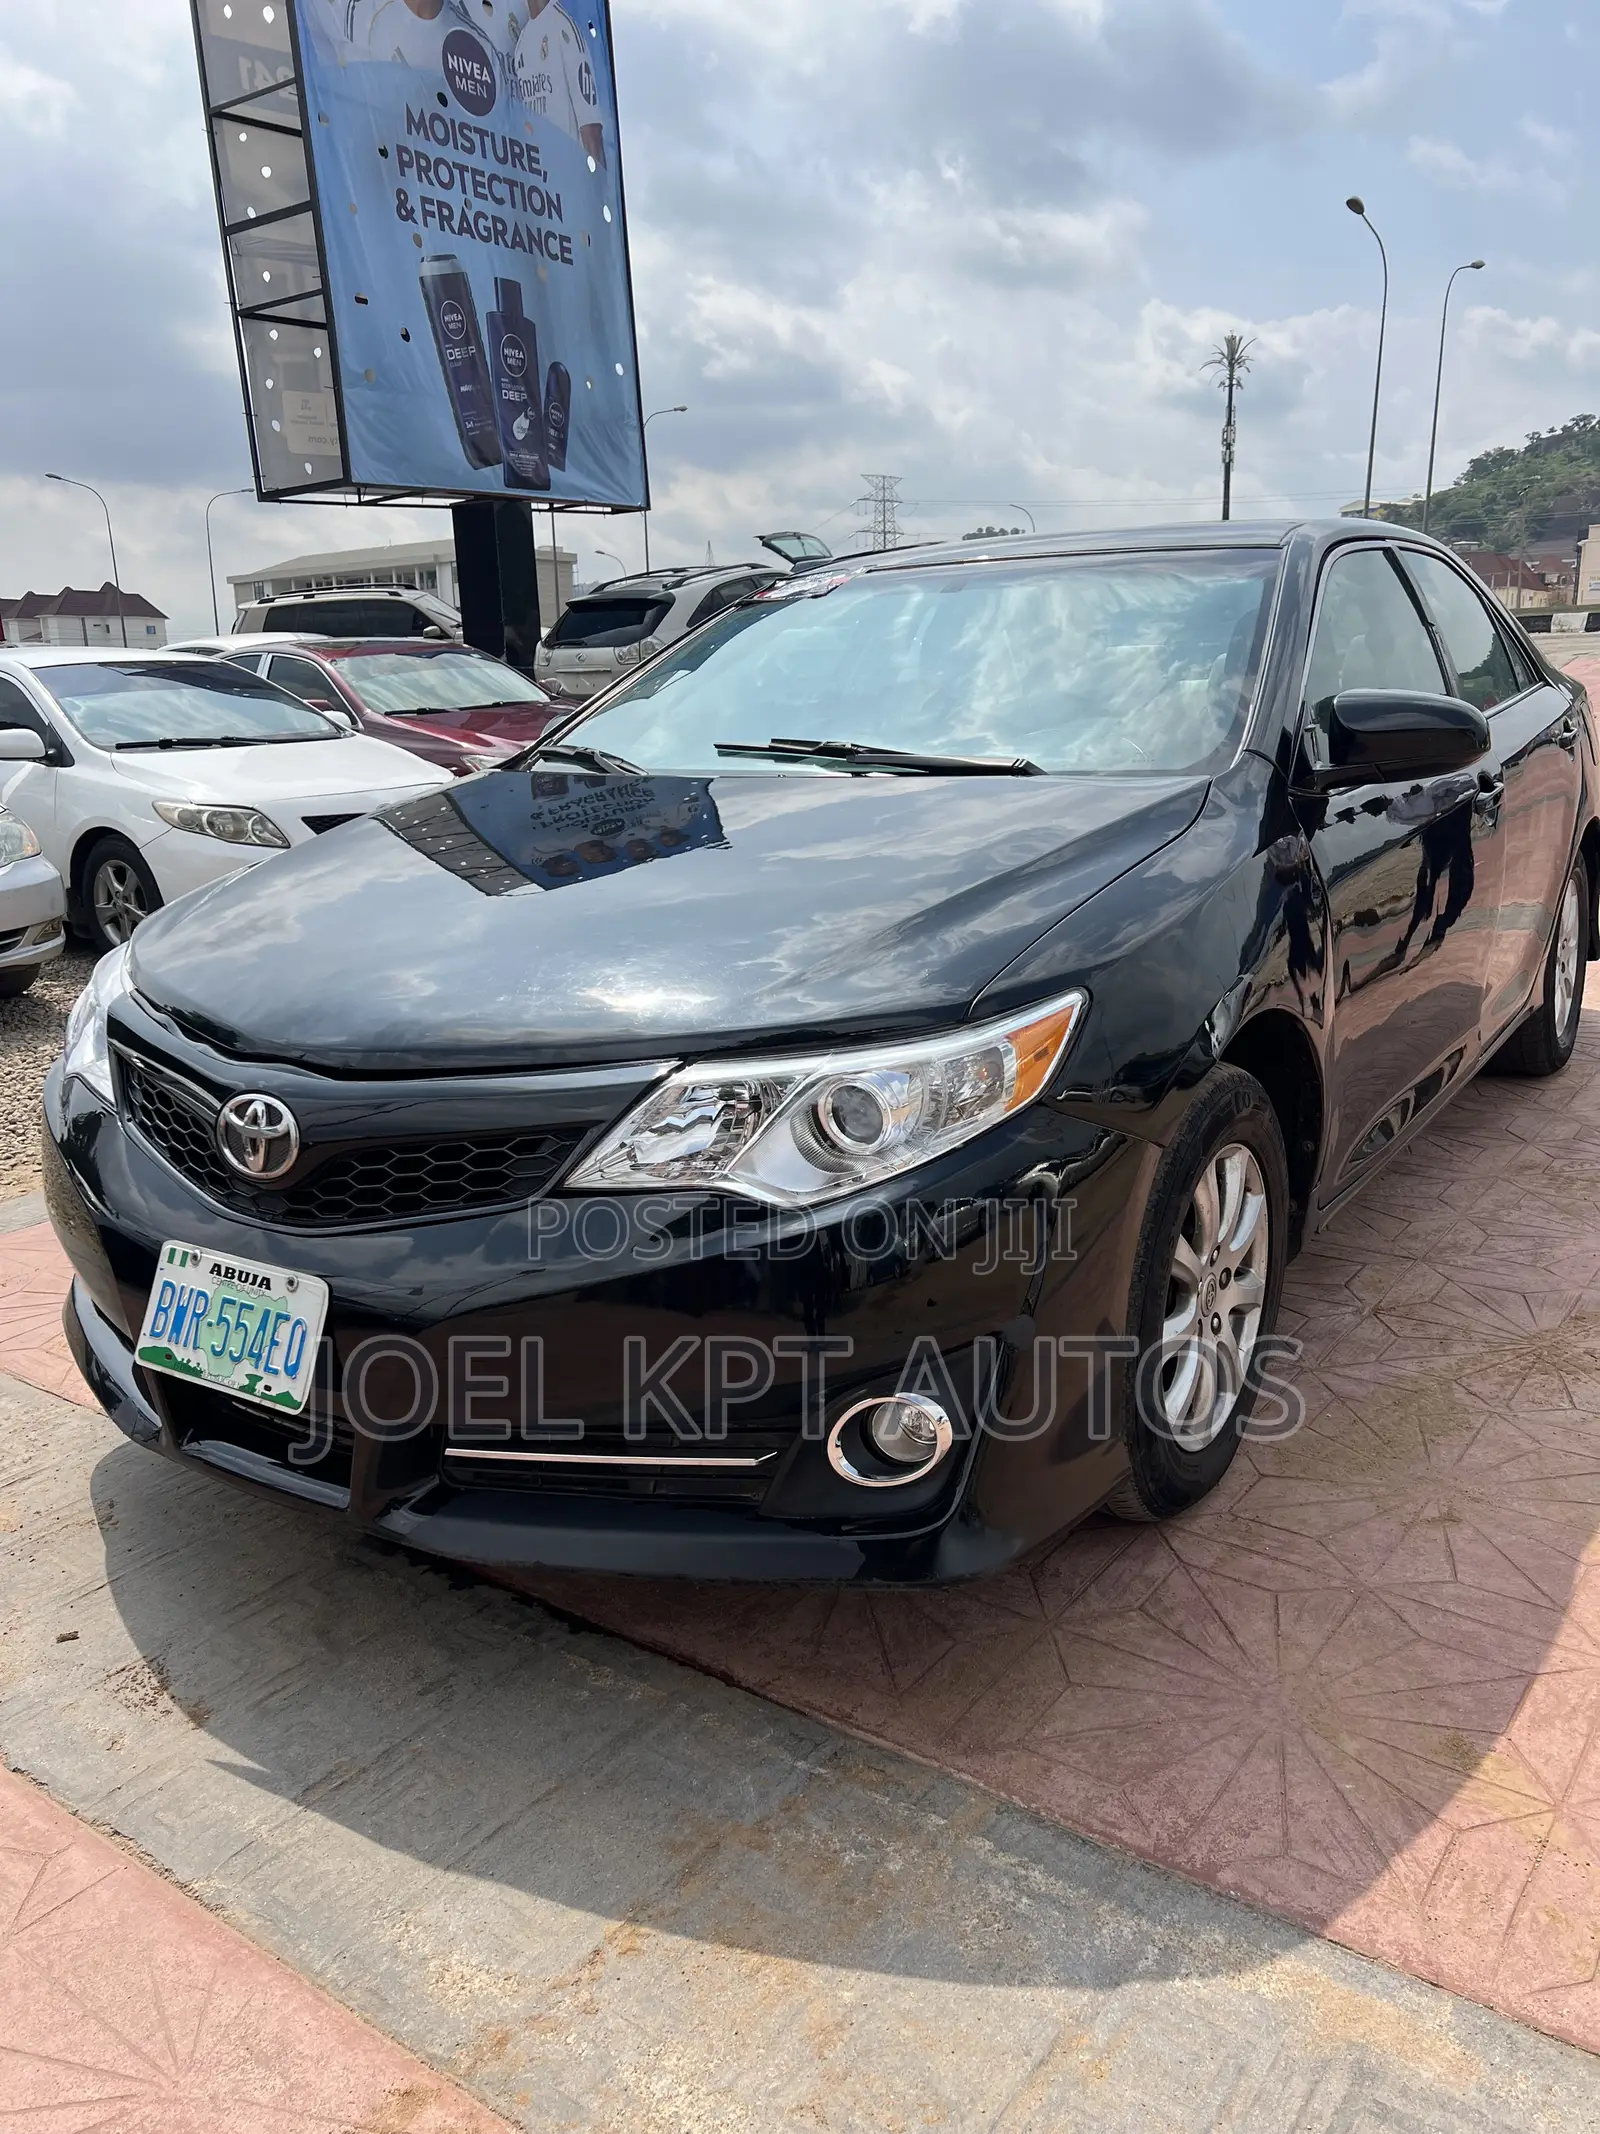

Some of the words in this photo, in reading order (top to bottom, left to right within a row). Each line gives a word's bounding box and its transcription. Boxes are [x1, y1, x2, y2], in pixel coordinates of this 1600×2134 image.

[447, 52, 491, 84] NIVEA
[455, 75, 487, 98] MEN
[406, 101, 548, 183] MOISTURE,
[396, 143, 563, 223] PROTECTION
[396, 187, 419, 226] &
[420, 195, 574, 266] FRAGRANCE
[446, 346, 476, 360] DEEP
[503, 347, 525, 360] NIVEA
[502, 389, 528, 402] DEEP
[209, 1262, 272, 1290] ABUJA
